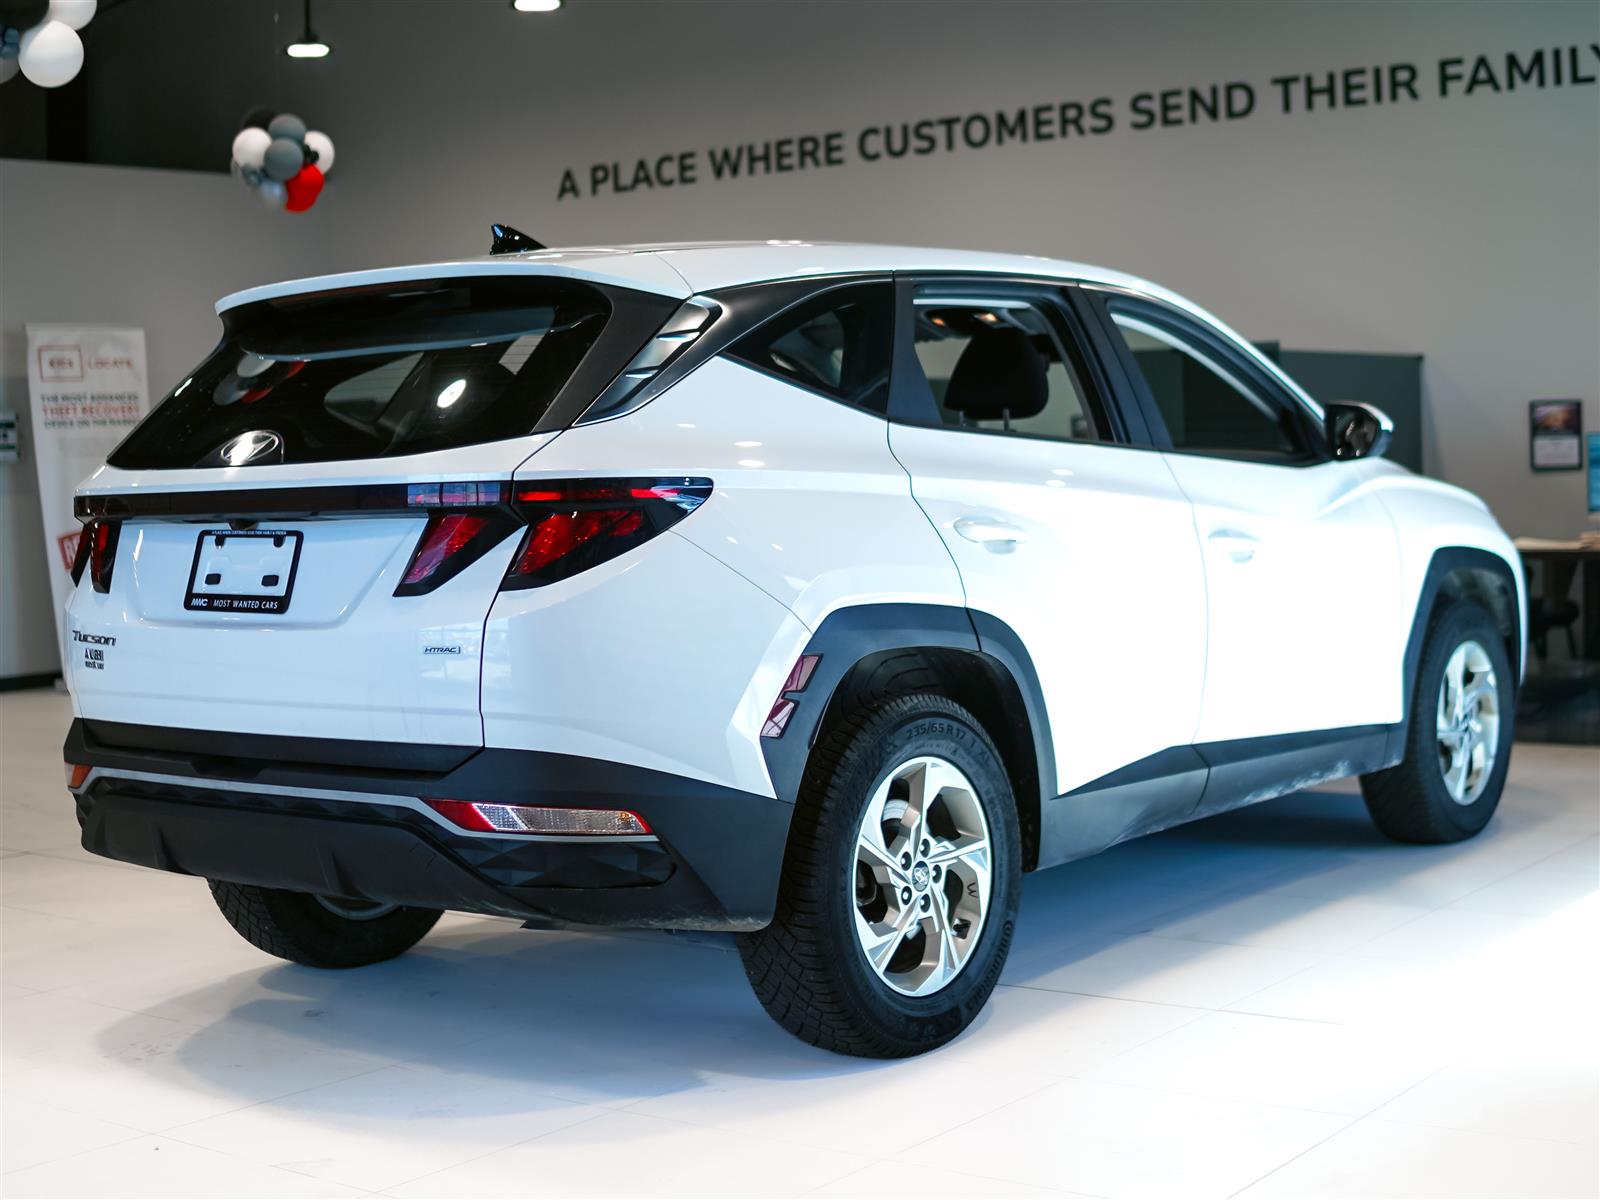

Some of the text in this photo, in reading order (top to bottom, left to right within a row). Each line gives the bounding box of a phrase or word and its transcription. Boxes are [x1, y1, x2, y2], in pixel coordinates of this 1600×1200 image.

[556, 169, 581, 201] A
[590, 151, 697, 197] PLACE
[707, 131, 845, 181] WHERE
[857, 97, 1115, 163] CUSTOMERS
[1129, 81, 1257, 131] SEND
[1270, 62, 1420, 115] THEIR
[213, 599, 231, 608] MOST
[233, 600, 259, 609] WANTED
[261, 601, 278, 609] CARS
